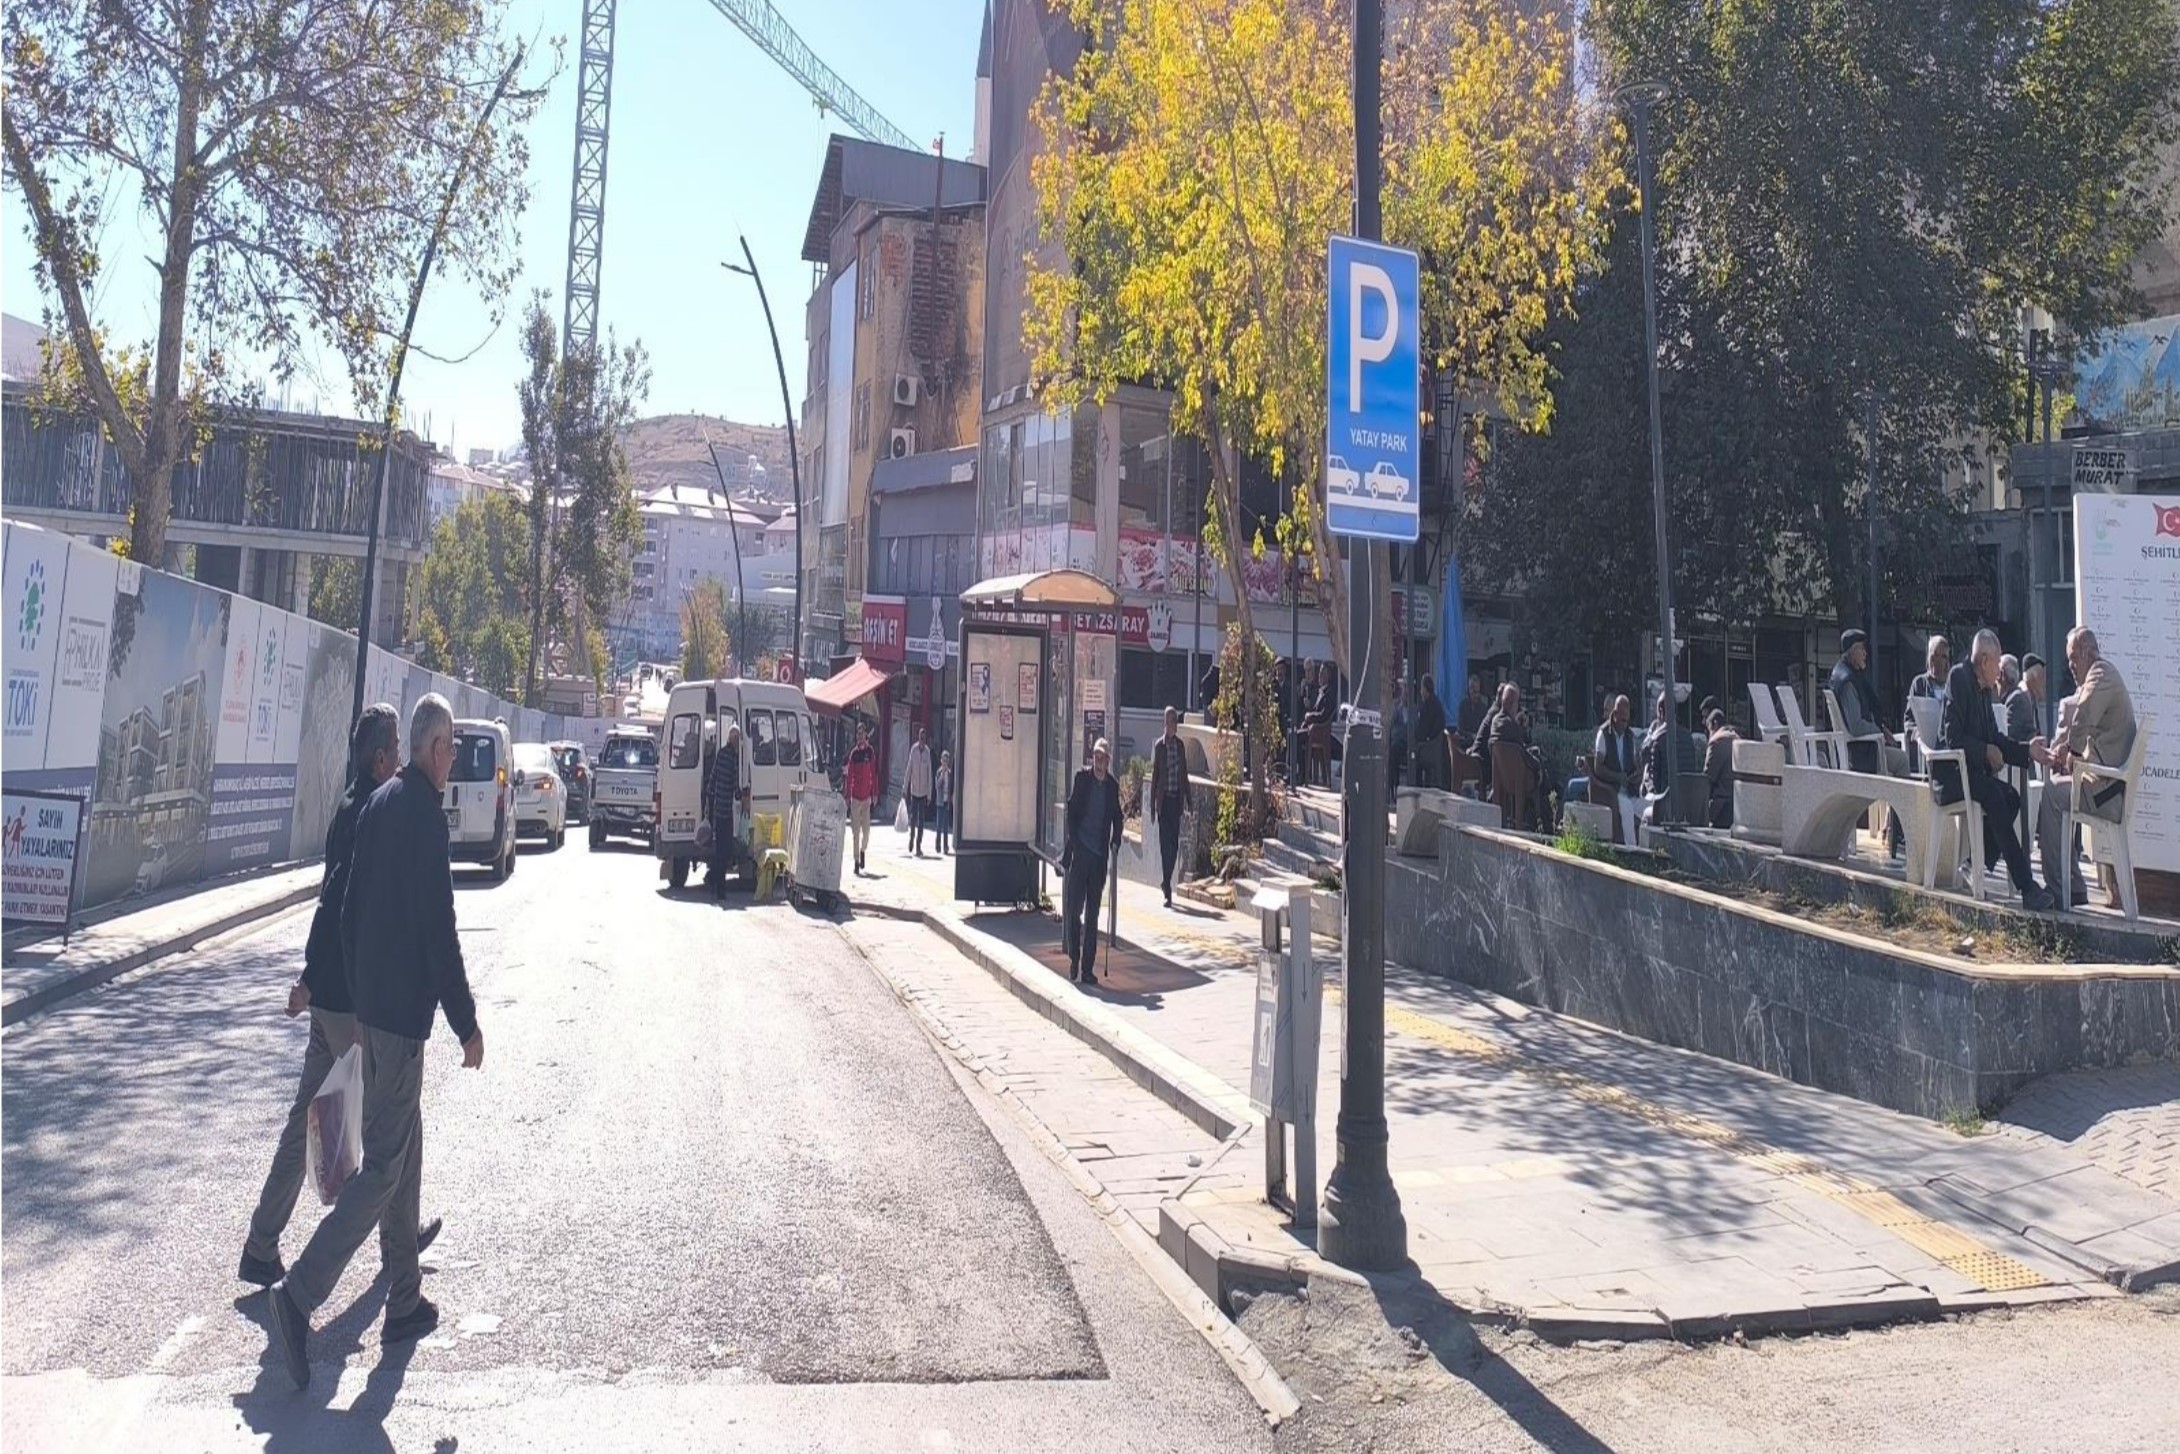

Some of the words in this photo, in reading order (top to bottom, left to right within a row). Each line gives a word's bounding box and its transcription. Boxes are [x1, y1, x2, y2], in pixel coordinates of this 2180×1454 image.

[1350, 260, 1399, 413] P
[1350, 428, 1379, 448] YATAY
[1381, 432, 1407, 452] PARK
[2075, 451, 2126, 469] BERBER
[2075, 469, 2125, 485] MURAT
[611, 786, 638, 796] TOYOTA
[38, 808, 63, 830] SAYIN
[21, 837, 73, 860] YAYALARIMIZ
